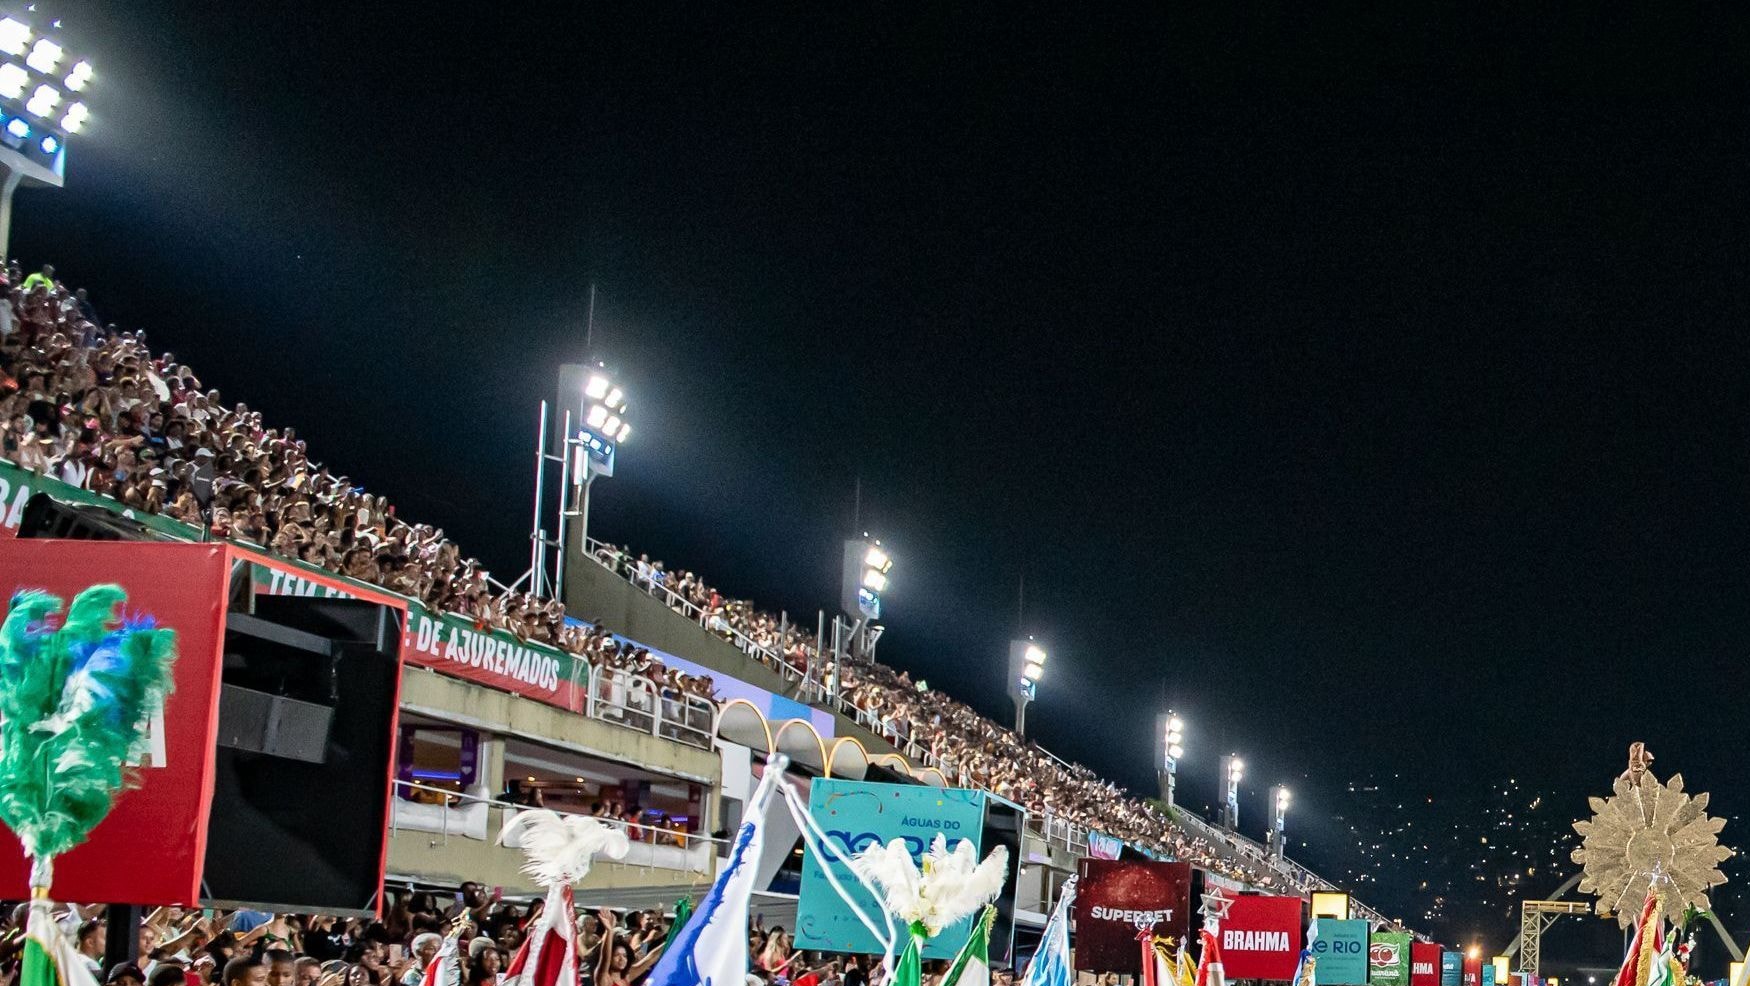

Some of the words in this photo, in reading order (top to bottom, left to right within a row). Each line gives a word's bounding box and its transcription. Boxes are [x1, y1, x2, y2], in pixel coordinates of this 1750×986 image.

[416, 616, 444, 657] DE
[445, 626, 561, 693] AJUREMADOS
[943, 820, 960, 830] DO
[1223, 930, 1290, 952] BRAHMA
[1333, 940, 1361, 954] RIO
[1412, 962, 1434, 975] HMA
